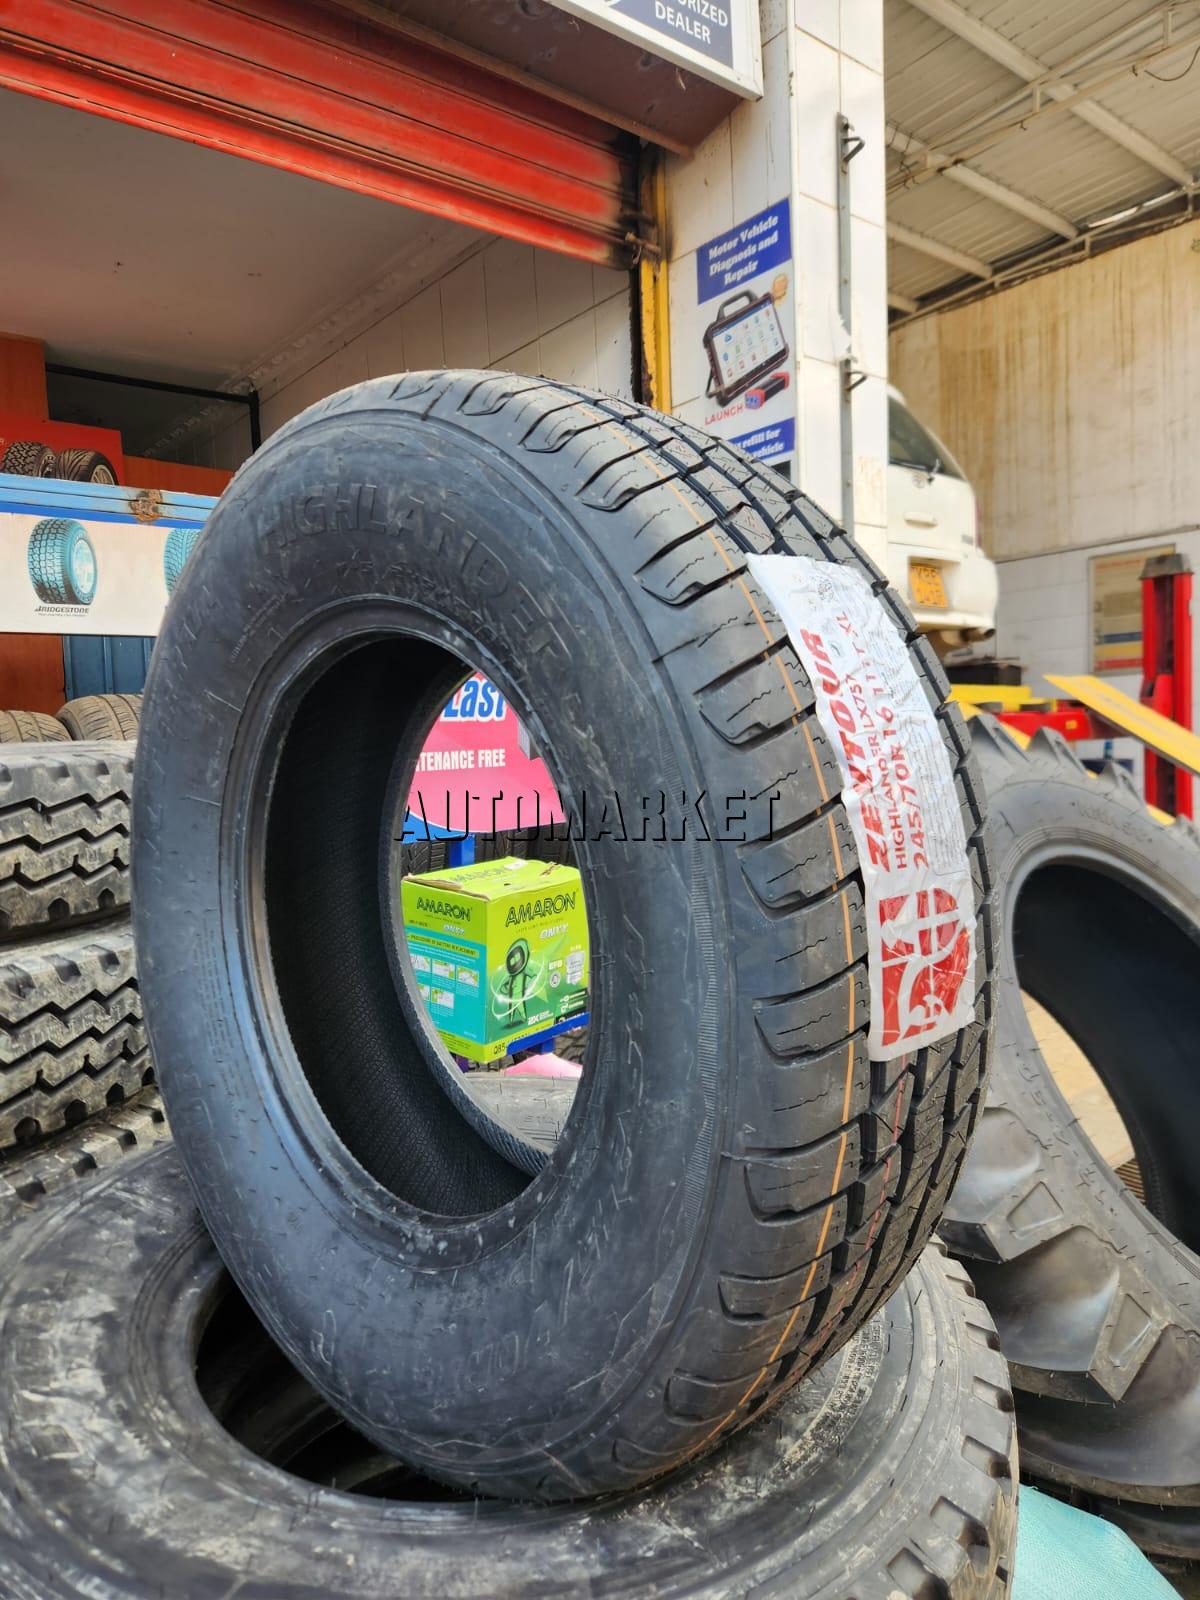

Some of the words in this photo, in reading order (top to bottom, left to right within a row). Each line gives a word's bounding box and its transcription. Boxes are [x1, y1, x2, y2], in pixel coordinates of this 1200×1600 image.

[655, 1, 711, 44] DEALER
[708, 238, 739, 260] Motor
[740, 215, 779, 243] Vehicle
[709, 244, 757, 277] Diagnosis
[758, 230, 779, 251] and
[724, 260, 759, 285] Repair
[705, 402, 743, 425] LAUNCH
[766, 428, 782, 440] for
[34, 604, 90, 614] BRIDGESTONE
[415, 750, 475, 772] TENANCE
[478, 748, 506, 768] FREE
[867, 734, 907, 869] HIGHLANDER
[416, 896, 471, 922] AMARON
[505, 891, 576, 928] AMARON
